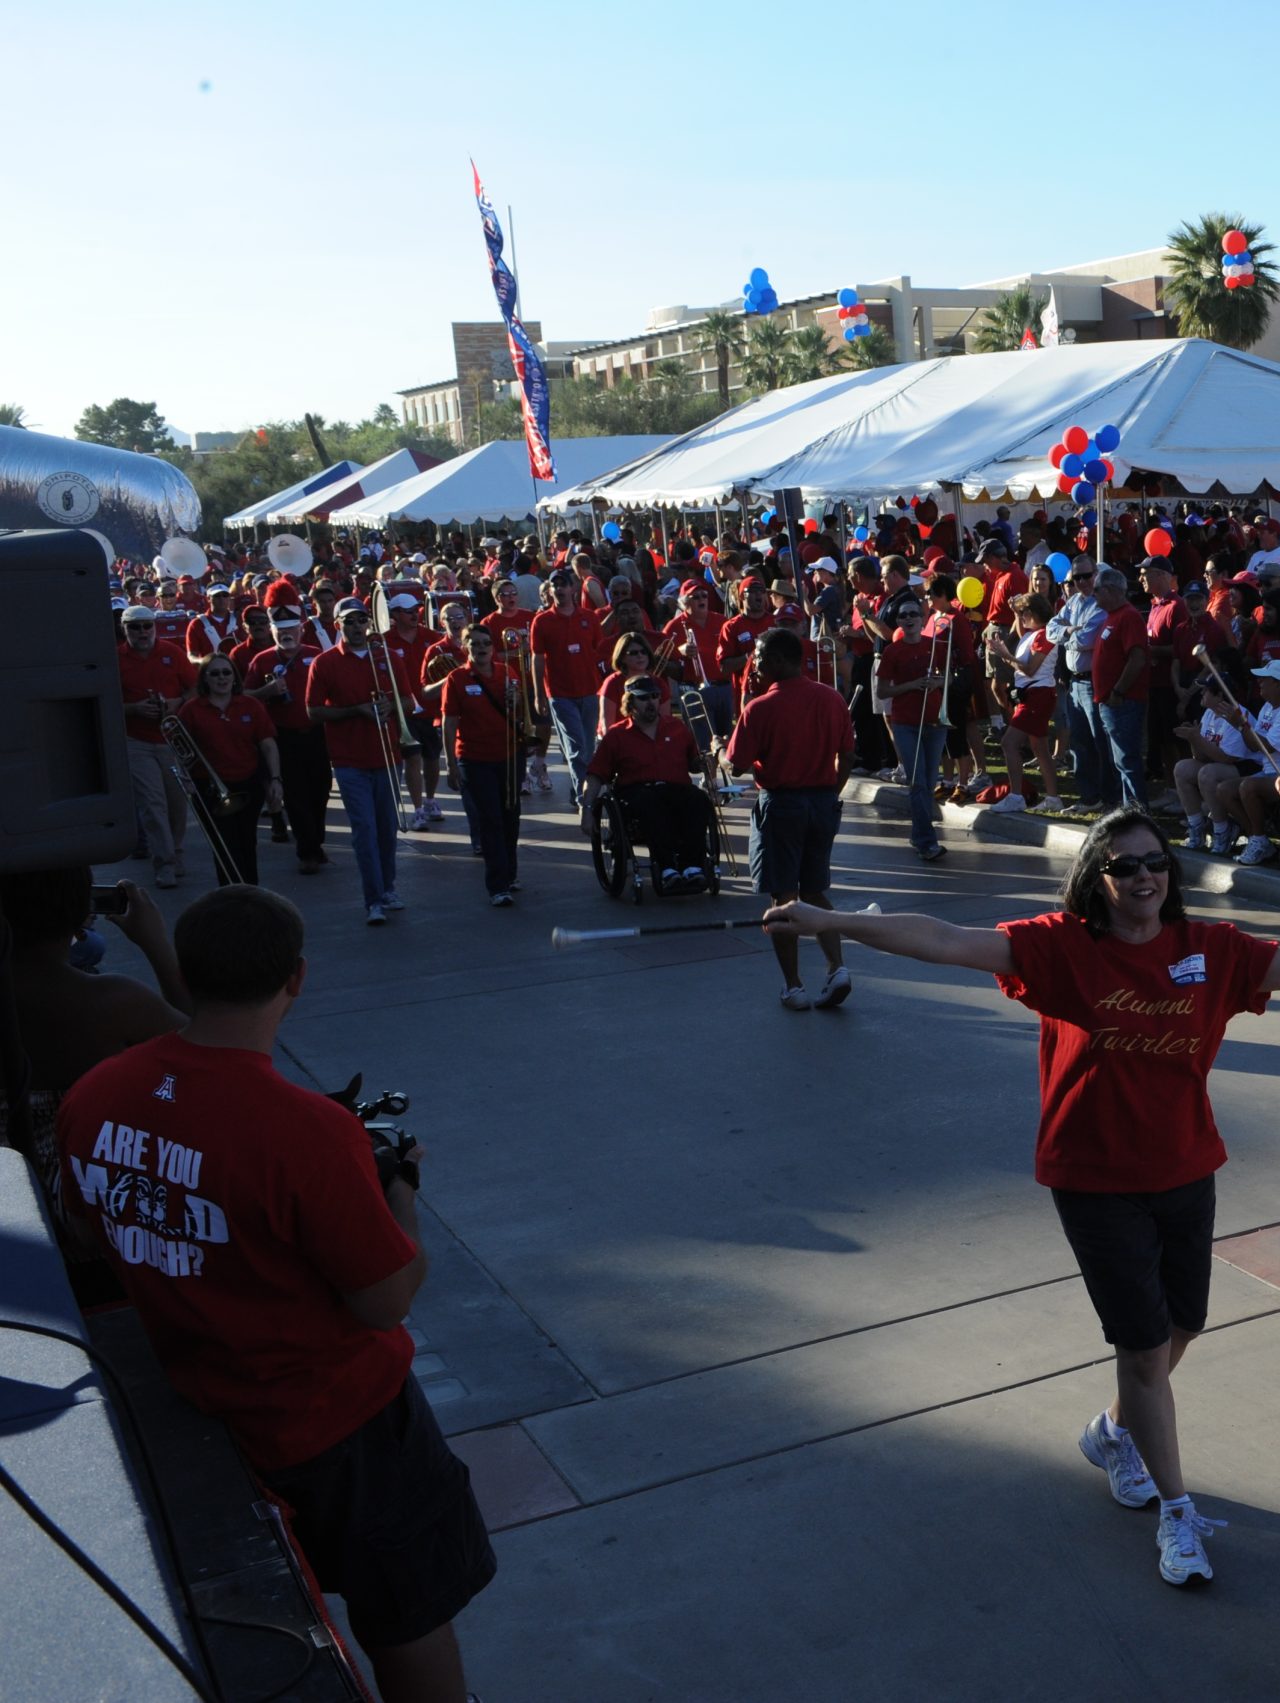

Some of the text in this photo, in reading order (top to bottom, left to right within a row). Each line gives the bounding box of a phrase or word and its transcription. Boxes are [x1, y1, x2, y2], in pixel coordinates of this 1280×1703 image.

[45, 473, 96, 496] CHIPOTLE
[1094, 988, 1195, 1016] Alumni
[1090, 1026, 1201, 1055] Twirler
[152, 1074, 177, 1103] A
[92, 1120, 203, 1190] ARE YOU
[101, 1213, 205, 1277] ENOUGH?
